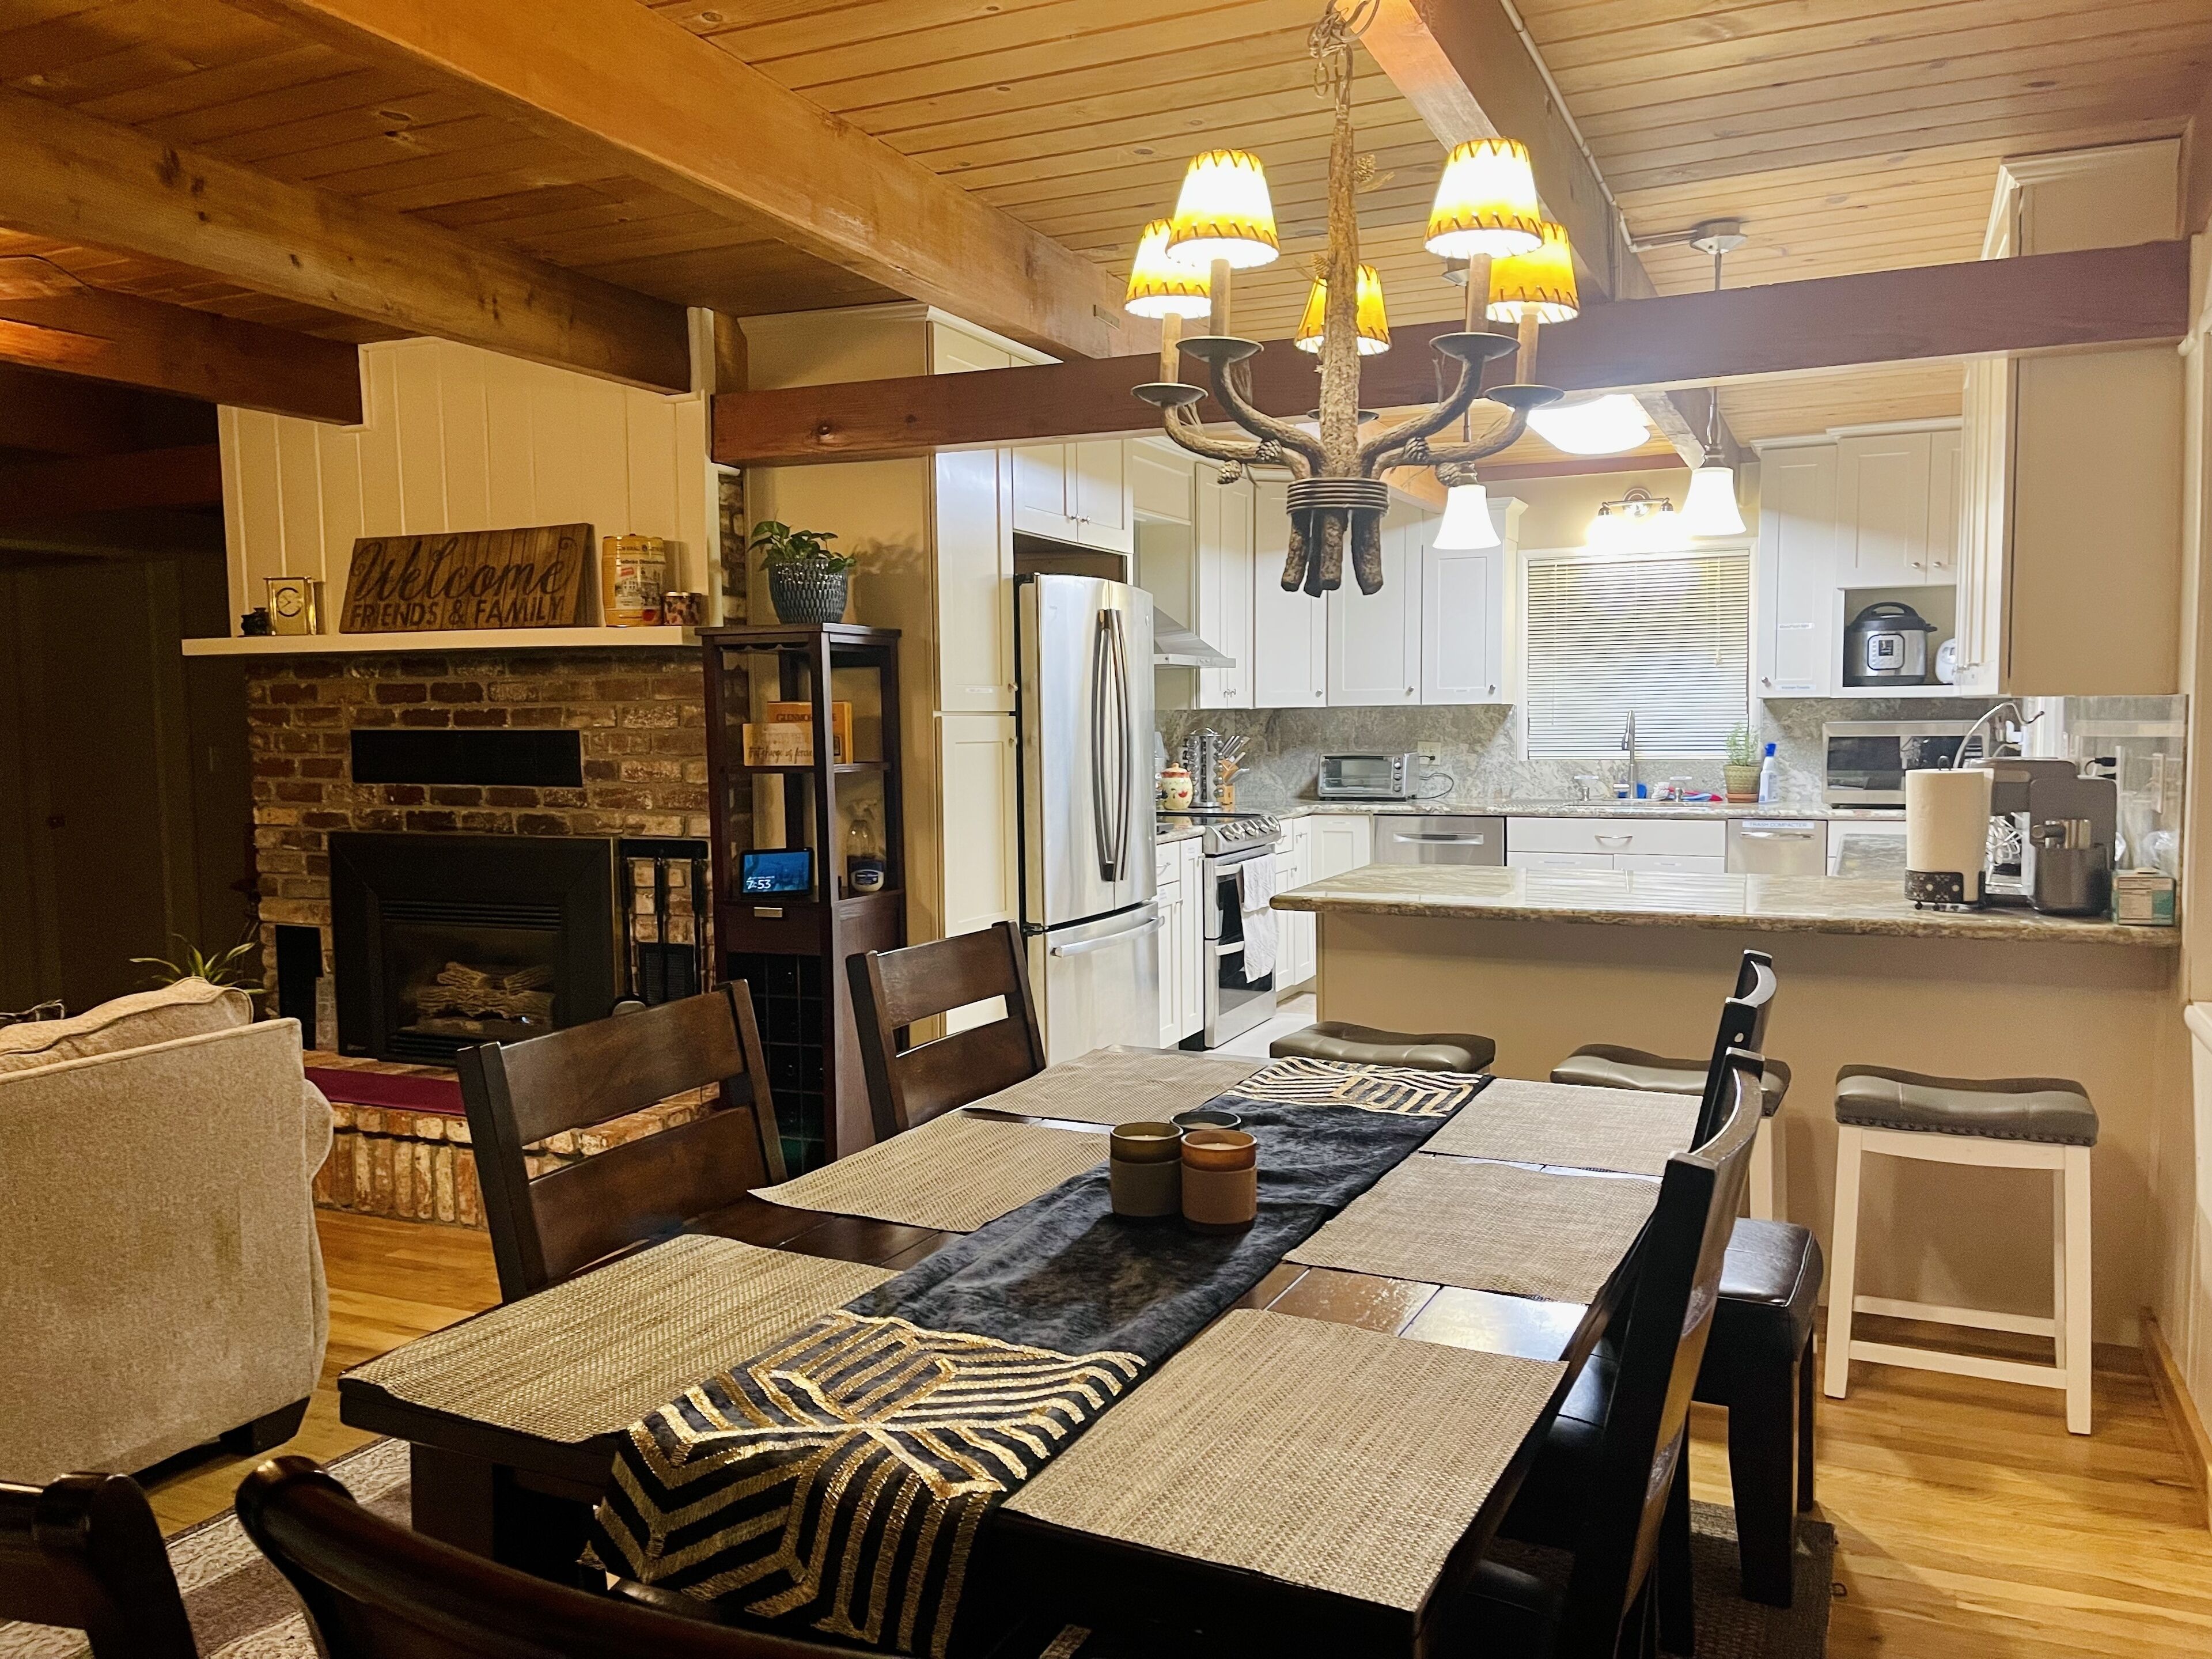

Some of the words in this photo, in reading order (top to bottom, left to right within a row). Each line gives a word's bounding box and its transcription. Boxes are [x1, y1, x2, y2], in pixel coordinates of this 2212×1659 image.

[353, 536, 576, 601] Welcome
[349, 601, 438, 627] FRIENDS
[448, 599, 466, 626] &
[475, 596, 565, 624] FAMILY
